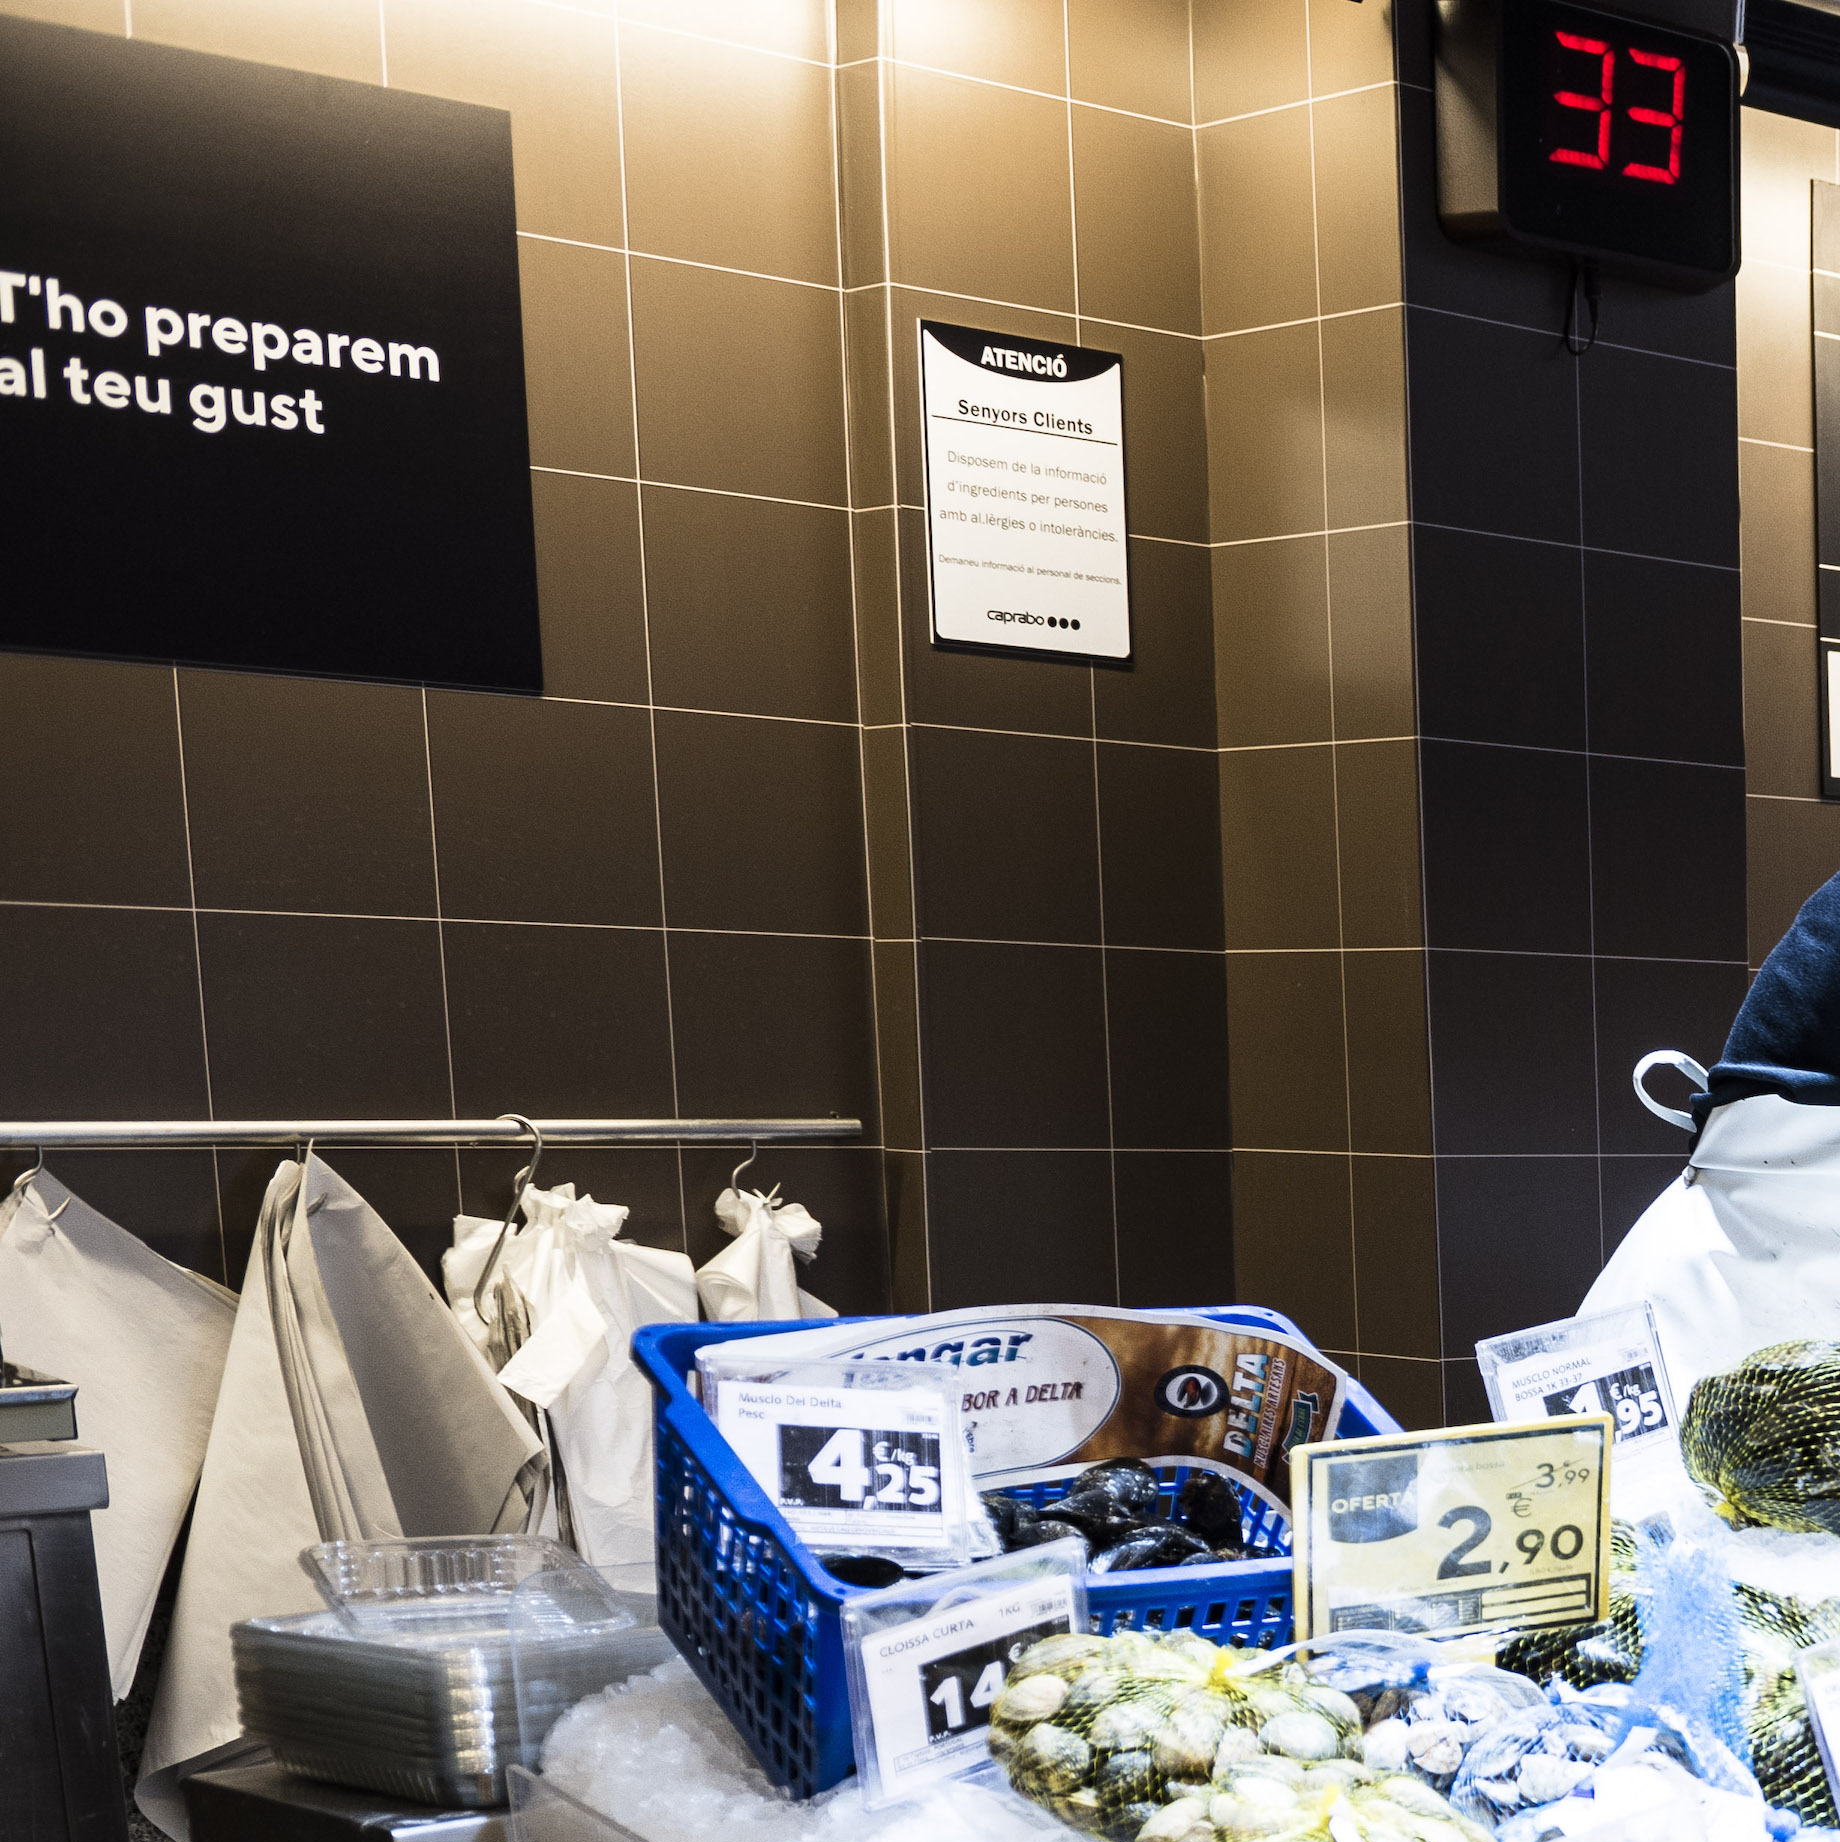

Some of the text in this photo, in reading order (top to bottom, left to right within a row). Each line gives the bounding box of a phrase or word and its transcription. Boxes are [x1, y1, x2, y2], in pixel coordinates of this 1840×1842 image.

[1550, 30, 1685, 185] 33
[0, 270, 441, 382] T'ho preparem
[981, 345, 1068, 378] ATENCIÓ
[0, 348, 325, 433] al teu gust
[958, 399, 1093, 435] Senyors Clients
[947, 450, 1107, 485] Disposem de la informació
[947, 480, 1108, 514] d'ingredients per persones
[939, 507, 967, 523] amb
[1029, 520, 1036, 531] o
[1040, 521, 1118, 543] intoleràncies.
[938, 554, 979, 568] Demaneu
[981, 559, 1025, 574] informació
[1026, 565, 1034, 575] al
[1036, 567, 1071, 581] personal
[1073, 570, 1083, 581] de
[987, 609, 1044, 626] caprabo
[1512, 1357, 1593, 1389] MUSCLO NORMAL
[961, 1389, 1000, 1413] BOR
[1025, 1381, 1083, 1404] DELTA
[1223, 1353, 1268, 1458] DELTA
[1515, 1386, 1544, 1402] BOSSA
[738, 1408, 765, 1420] Pesc
[807, 1429, 941, 1511] 4,25
[1535, 1462, 1590, 1488] 3,99
[1331, 1491, 1414, 1514] OFERTA
[1511, 1498, 1532, 1518] €
[1437, 1505, 1584, 1580] 2,90
[879, 1633, 930, 1658] CLOISSA
[933, 1618, 975, 1639] CURTA
